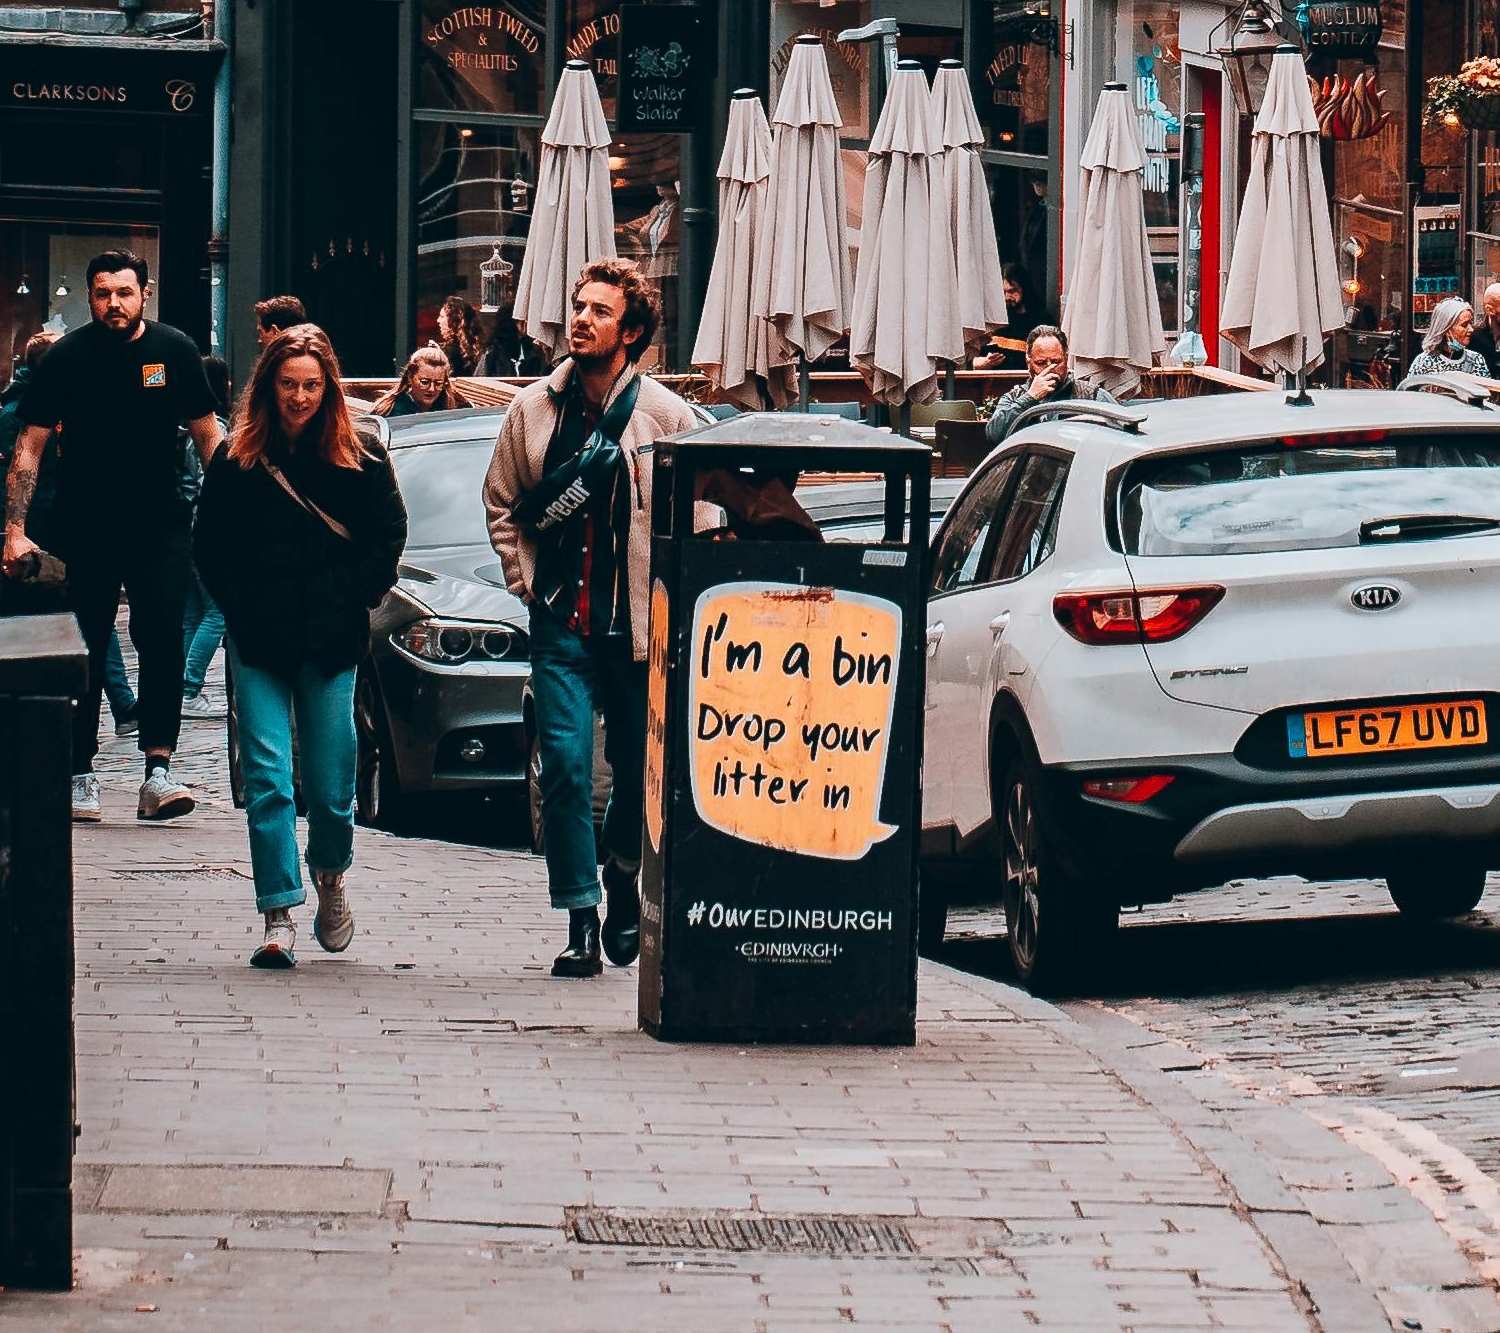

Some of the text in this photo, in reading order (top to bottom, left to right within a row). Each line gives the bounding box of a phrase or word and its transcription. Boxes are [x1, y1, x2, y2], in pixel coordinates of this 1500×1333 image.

[1309, 6, 1378, 25] MUSEUM
[427, 7, 539, 54] SCOTTISH TWEED
[478, 33, 488, 46] &
[566, 14, 620, 59] MADE TO
[1311, 32, 1376, 45] CONTEXT
[447, 51, 518, 71] SPECIALITIES
[13, 83, 126, 102] CLARKSONS
[634, 85, 686, 102] Walker
[636, 105, 683, 121] Slater
[1359, 587, 1394, 605] KIA
[701, 612, 892, 686] I'm a bin
[698, 703, 882, 761] Drop your
[1312, 702, 1481, 750] LF67 UVD
[713, 757, 850, 809] litter in
[687, 901, 892, 931] #OurEDINBURGH
